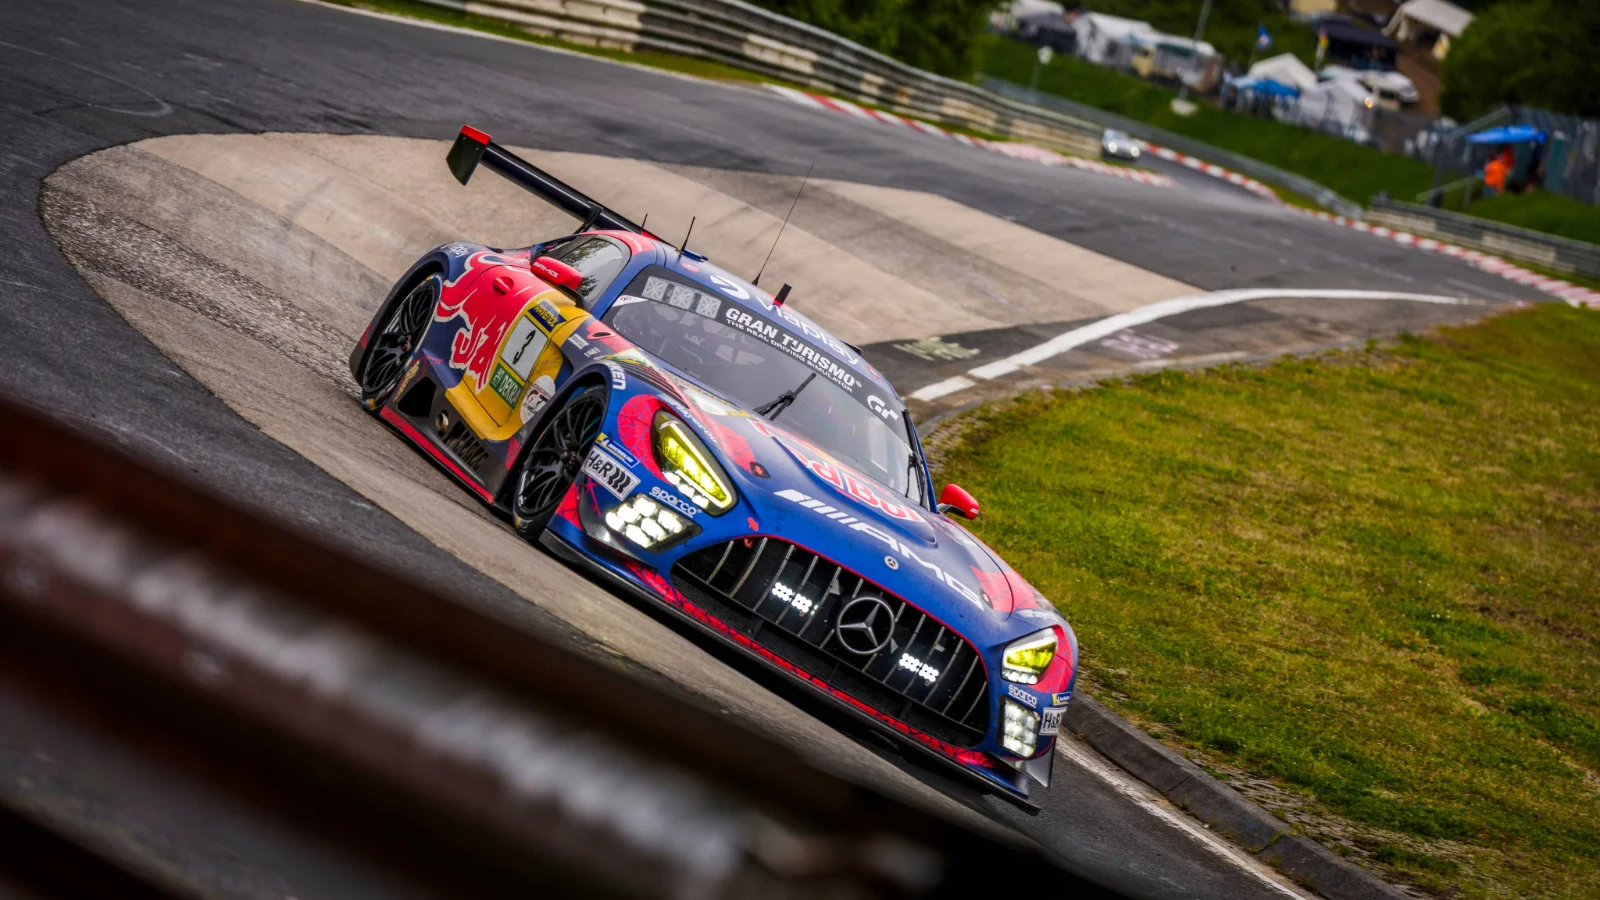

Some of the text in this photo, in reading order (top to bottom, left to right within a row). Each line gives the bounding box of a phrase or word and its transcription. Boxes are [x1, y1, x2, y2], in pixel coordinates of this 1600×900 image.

[512, 329, 536, 365] 3
[725, 307, 779, 339] GRAN
[782, 333, 856, 387] TURISMO
[725, 318, 745, 331] THE
[746, 326, 769, 342] REAL
[770, 339, 806, 362] DRIVING
[806, 359, 853, 393] SIMULATOR
[498, 374, 522, 407] DEKRA
[588, 450, 613, 478] H&R
[650, 486, 697, 516] sparco
[850, 522, 985, 611] AMG
[1008, 684, 1037, 707] sparco
